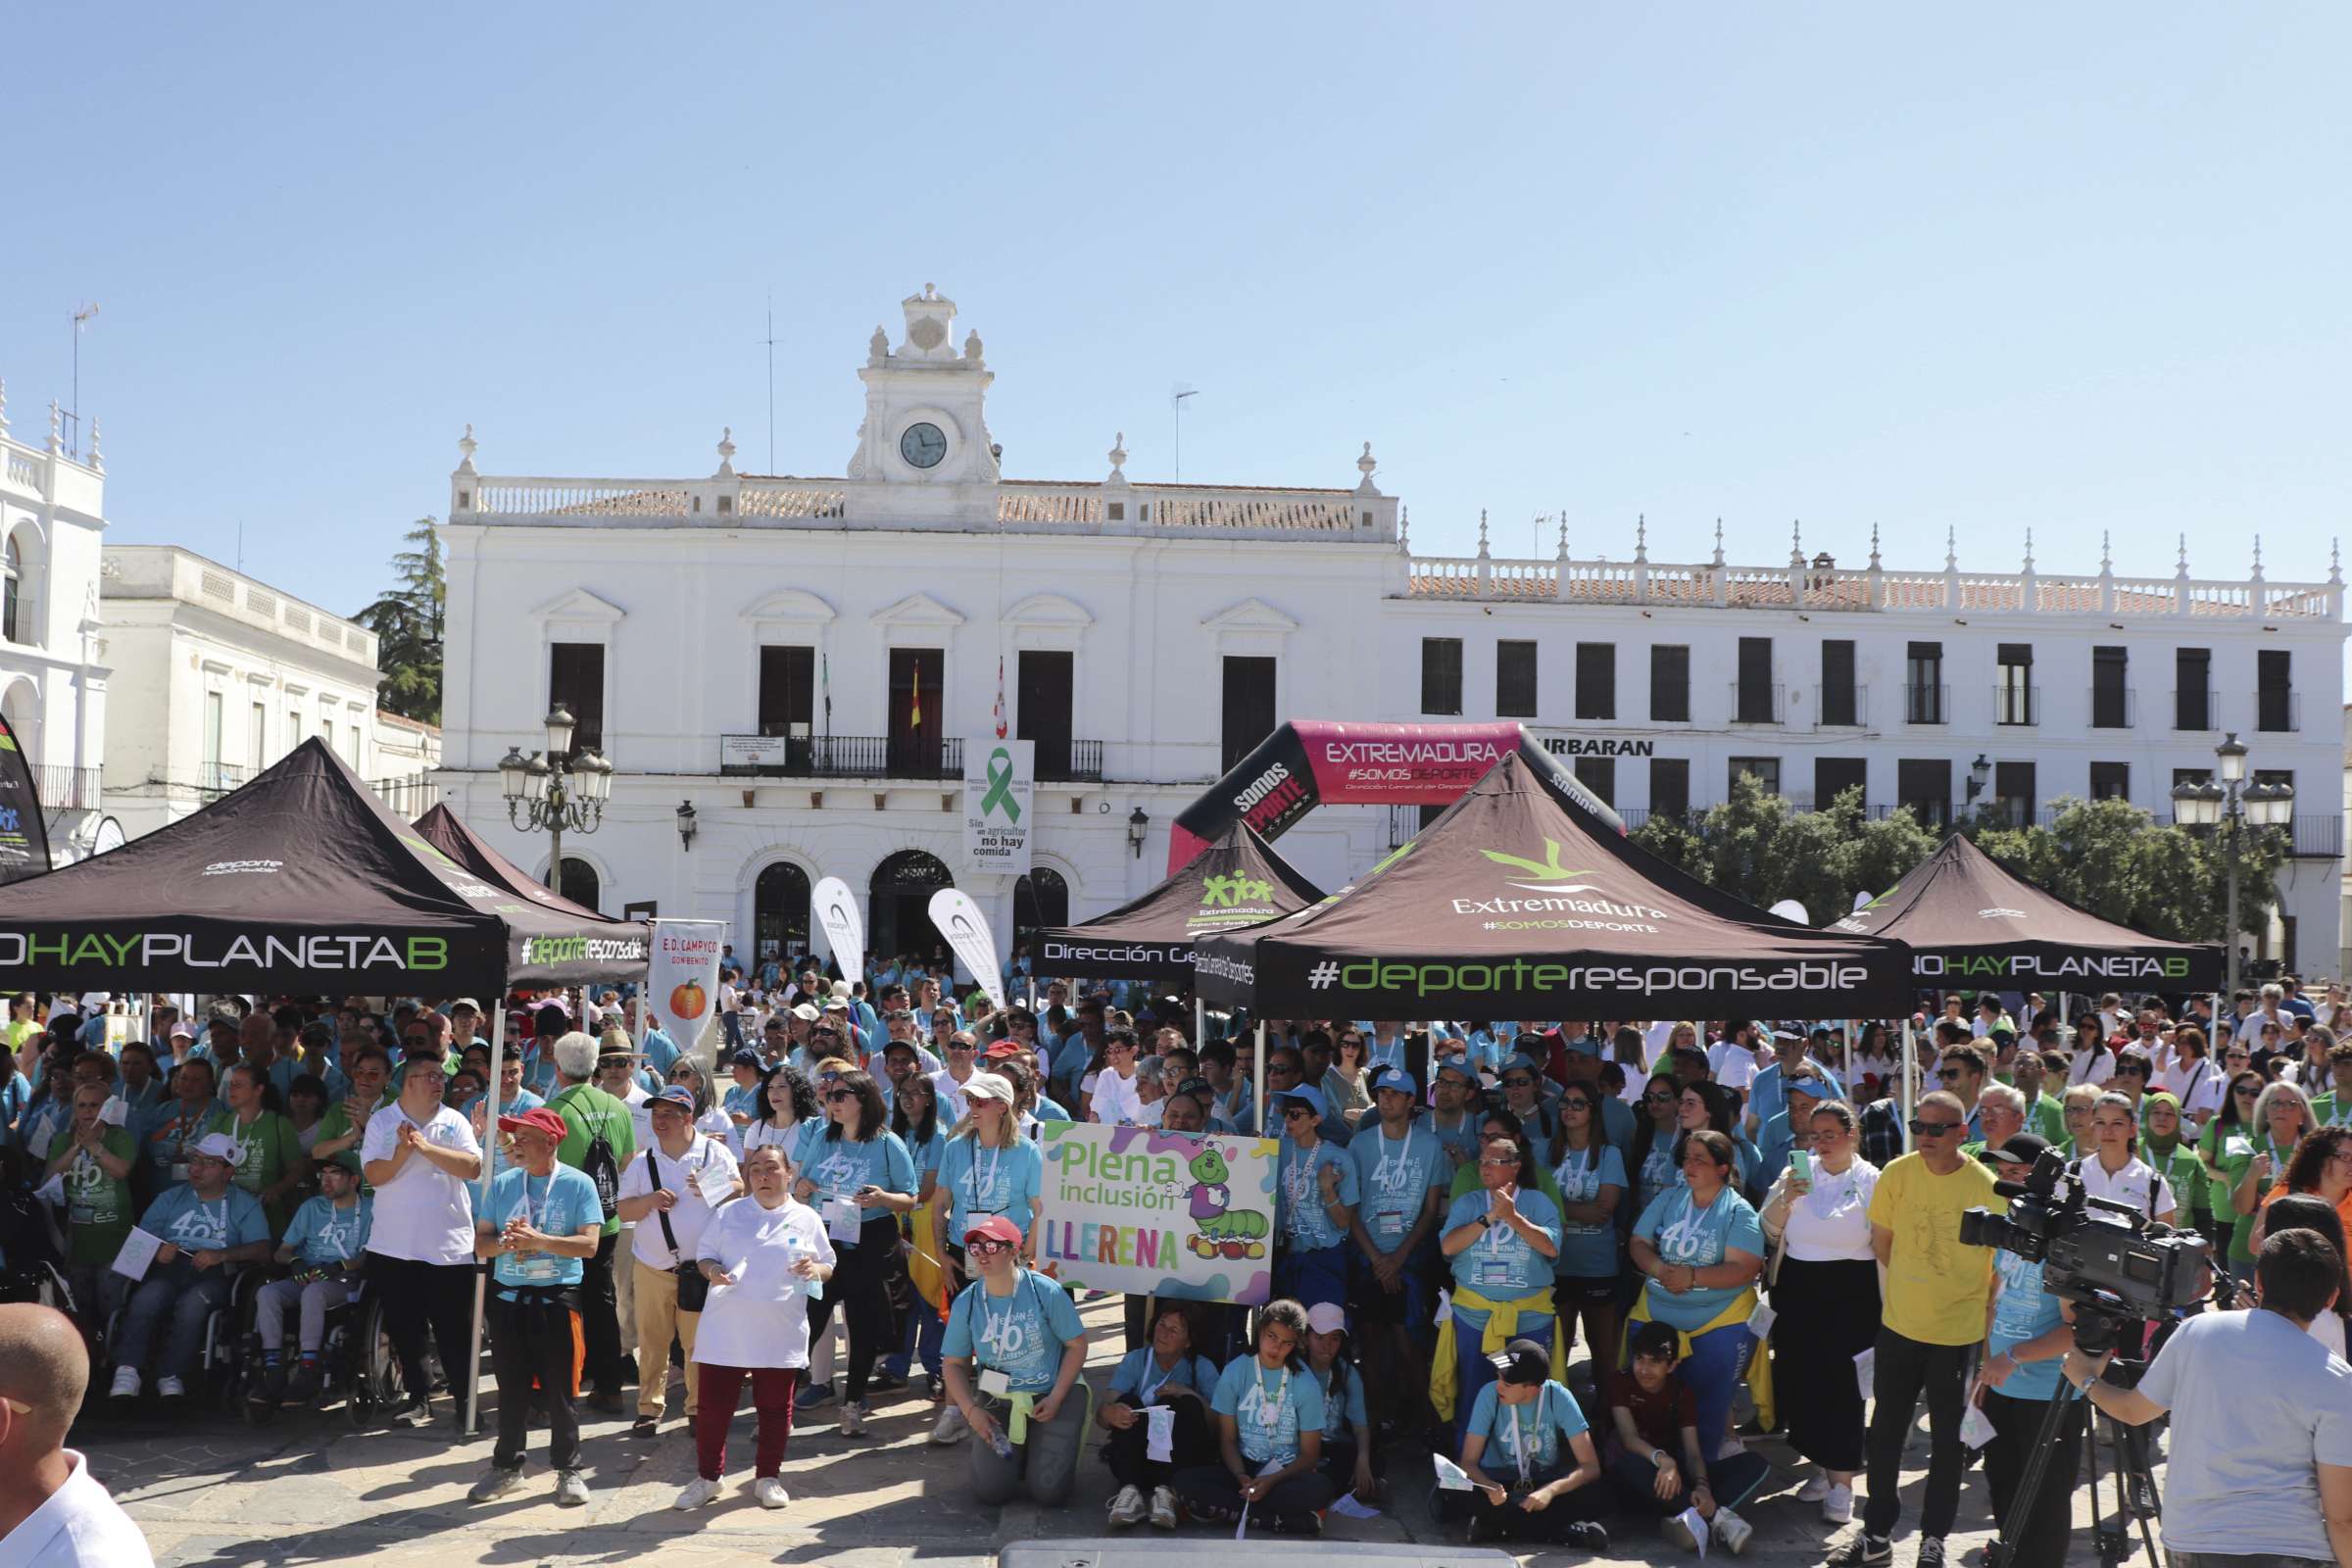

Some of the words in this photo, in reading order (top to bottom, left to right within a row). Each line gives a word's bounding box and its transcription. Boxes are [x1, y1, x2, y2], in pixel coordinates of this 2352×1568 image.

[1326, 743, 1499, 762] EXTREMADURA
[1543, 738, 1653, 756] RBARAN
[1348, 768, 1480, 781] #SOMOSDEPORTE
[1233, 761, 1290, 812] SOMOS
[1243, 775, 1304, 833] EPORTE
[968, 818, 984, 828] Sin
[987, 826, 1027, 838] agricultor
[973, 847, 1011, 857] comida
[981, 837, 998, 847] no
[1001, 836, 1024, 850] hay
[1199, 907, 1274, 916] Extremadura
[1451, 897, 1668, 919] Extremadura
[1483, 919, 1660, 933] #SOMOSDEPORTE
[521, 932, 642, 969] #deporteresponsable
[662, 938, 680, 952] E.D.
[681, 938, 718, 954] CAMPYCO
[1044, 943, 1163, 962] Dirección
[671, 956, 685, 965] DON
[686, 956, 710, 965] BENITO
[1307, 958, 1868, 998] #deporteresponsable
[1061, 1141, 1176, 1185] Plena
[1059, 1178, 1175, 1210] inclusión
[171, 1209, 212, 1240] 40
[1045, 1219, 1179, 1271] LLERENA
[1009, 1372, 1051, 1387] DES
